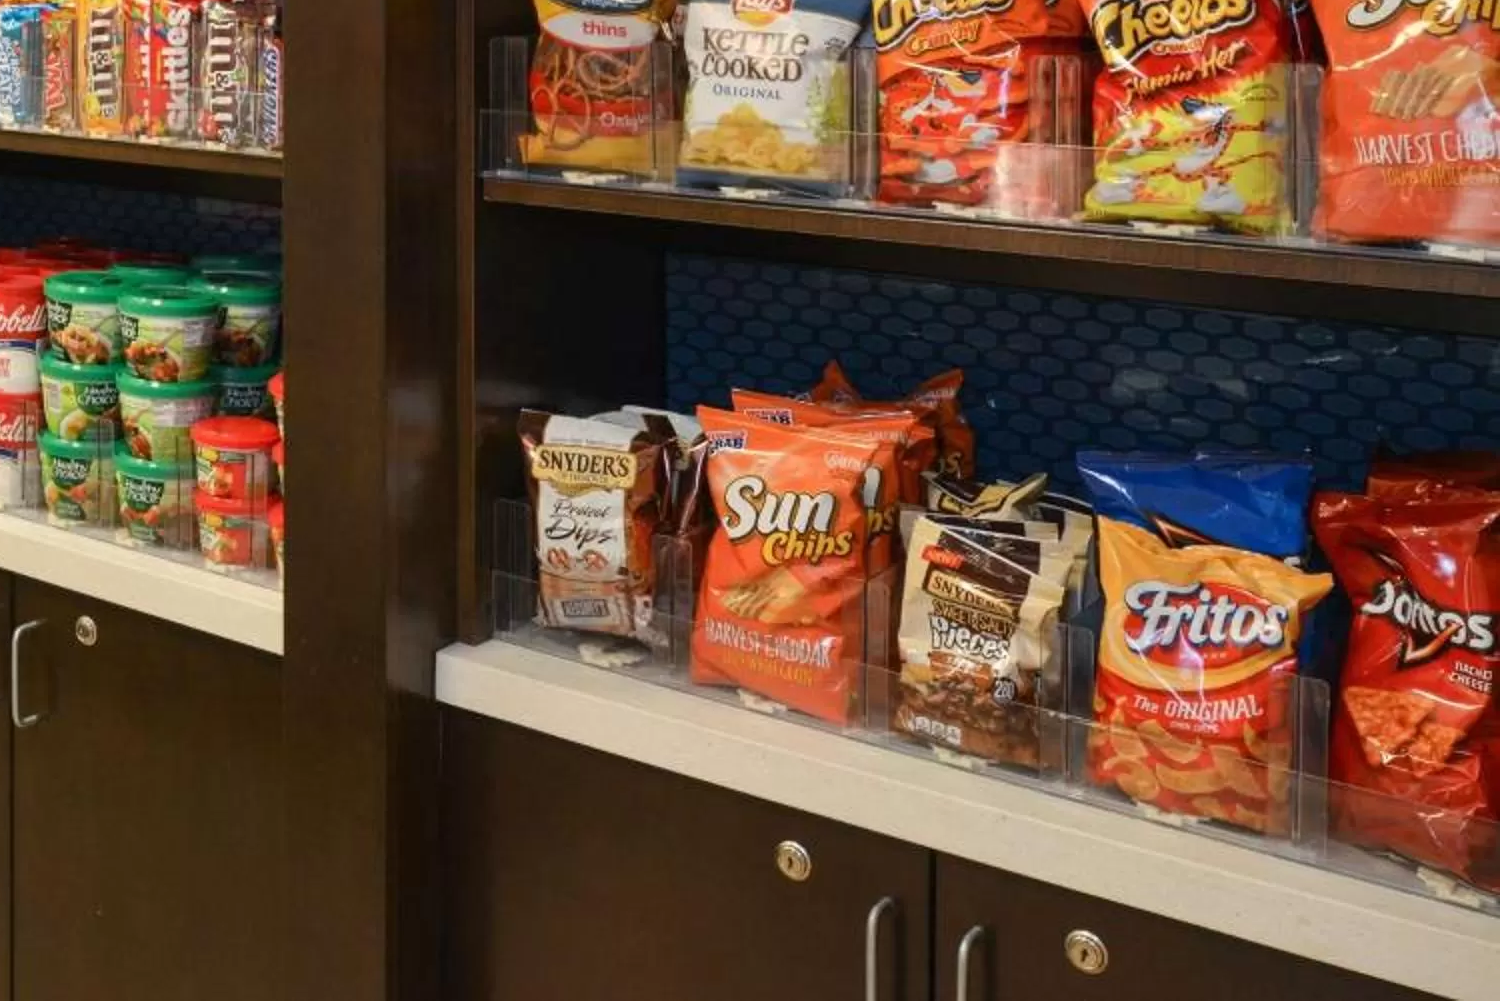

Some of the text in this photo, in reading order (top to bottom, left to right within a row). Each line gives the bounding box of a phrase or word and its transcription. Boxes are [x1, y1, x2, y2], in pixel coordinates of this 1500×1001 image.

[581, 20, 628, 39] thins
[161, 7, 192, 132] skittles
[712, 83, 782, 100] ORIGINAL
[1352, 133, 1434, 166] HARVEST
[539, 448, 630, 478] SNYDER'S
[724, 475, 834, 540] Sun
[544, 515, 618, 550] Dips
[762, 531, 852, 567] Chips
[1125, 579, 1288, 651] Fritos
[704, 616, 832, 669] HARVEST CHEDDAR
[930, 614, 1010, 659] Pieces
[1449, 671, 1493, 693] CHEESE
[1163, 694, 1264, 722] ORIGINAL
